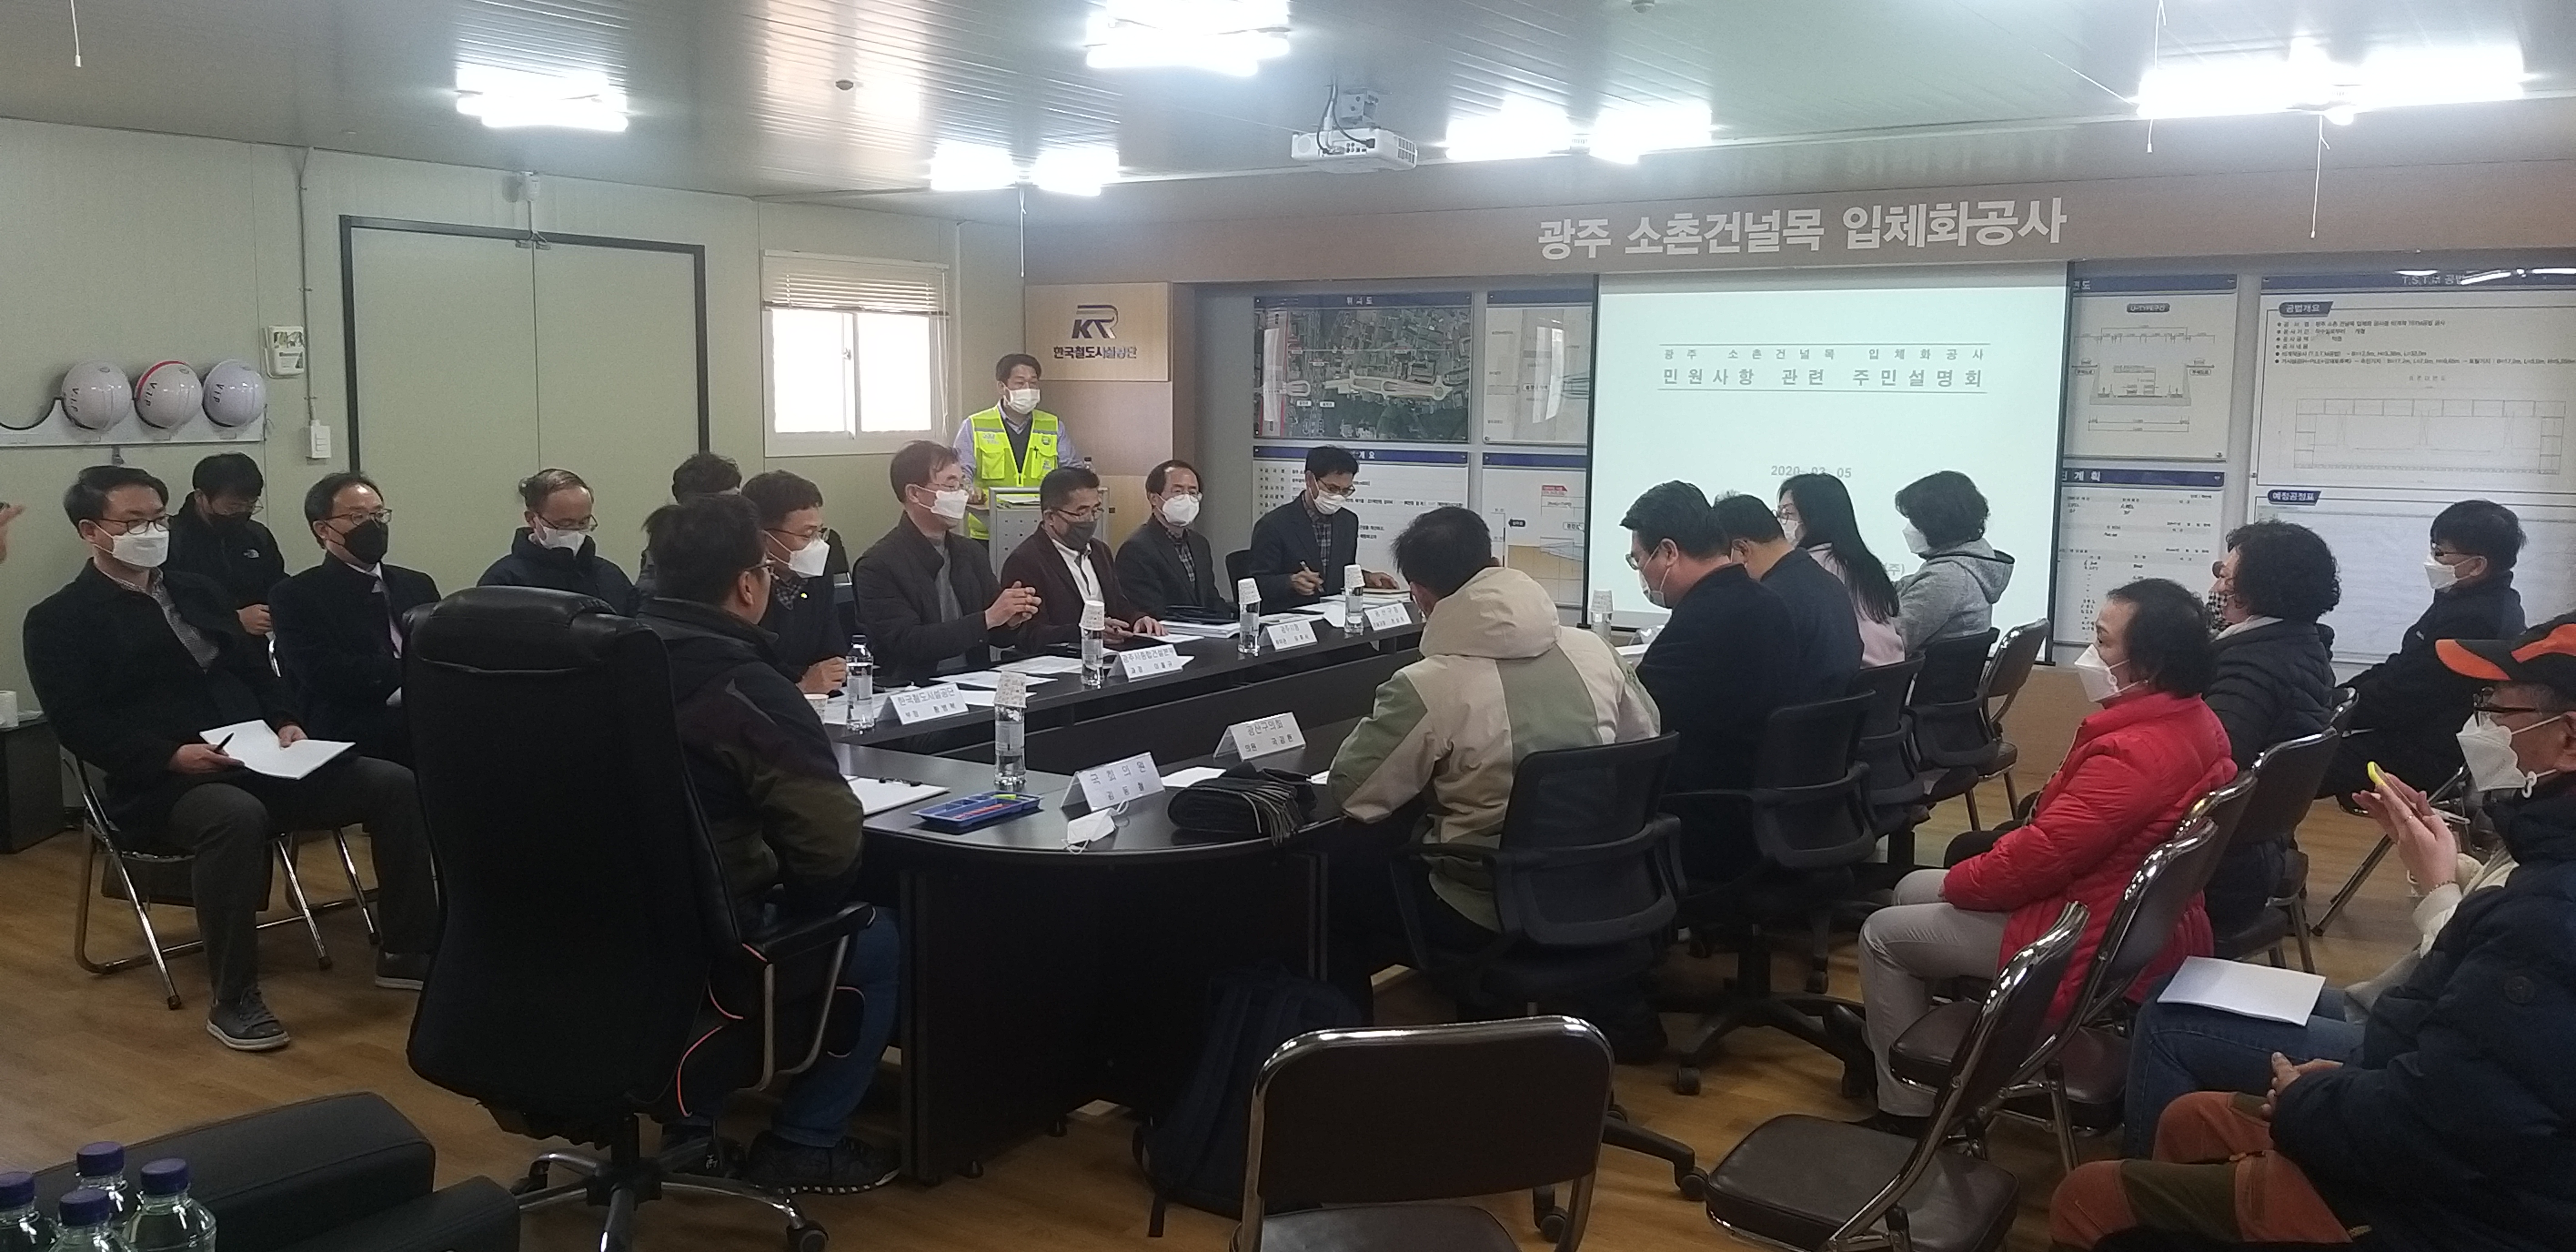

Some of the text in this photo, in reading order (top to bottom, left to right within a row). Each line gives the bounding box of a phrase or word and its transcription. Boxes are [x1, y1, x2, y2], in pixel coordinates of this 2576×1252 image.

[1538, 197, 2068, 260] 광주 소촌건널목 입체화공사
[2285, 304, 2320, 313] 공법개요
[1072, 305, 1119, 339] KR
[1053, 346, 1137, 359] 한국철도시설공단
[1664, 348, 1983, 360] 광주 소촌건널목 입체화공사
[1663, 369, 1981, 387] 민원사항 관련 주민설명회
[1836, 468, 1852, 478] 05
[2273, 492, 2314, 501] 예정공정표
[897, 687, 955, 706] 한국철도시설공단
[1246, 719, 1283, 736] 광산구의회
[1245, 743, 1257, 752] 의원
[1090, 761, 1146, 784] 국회의원
